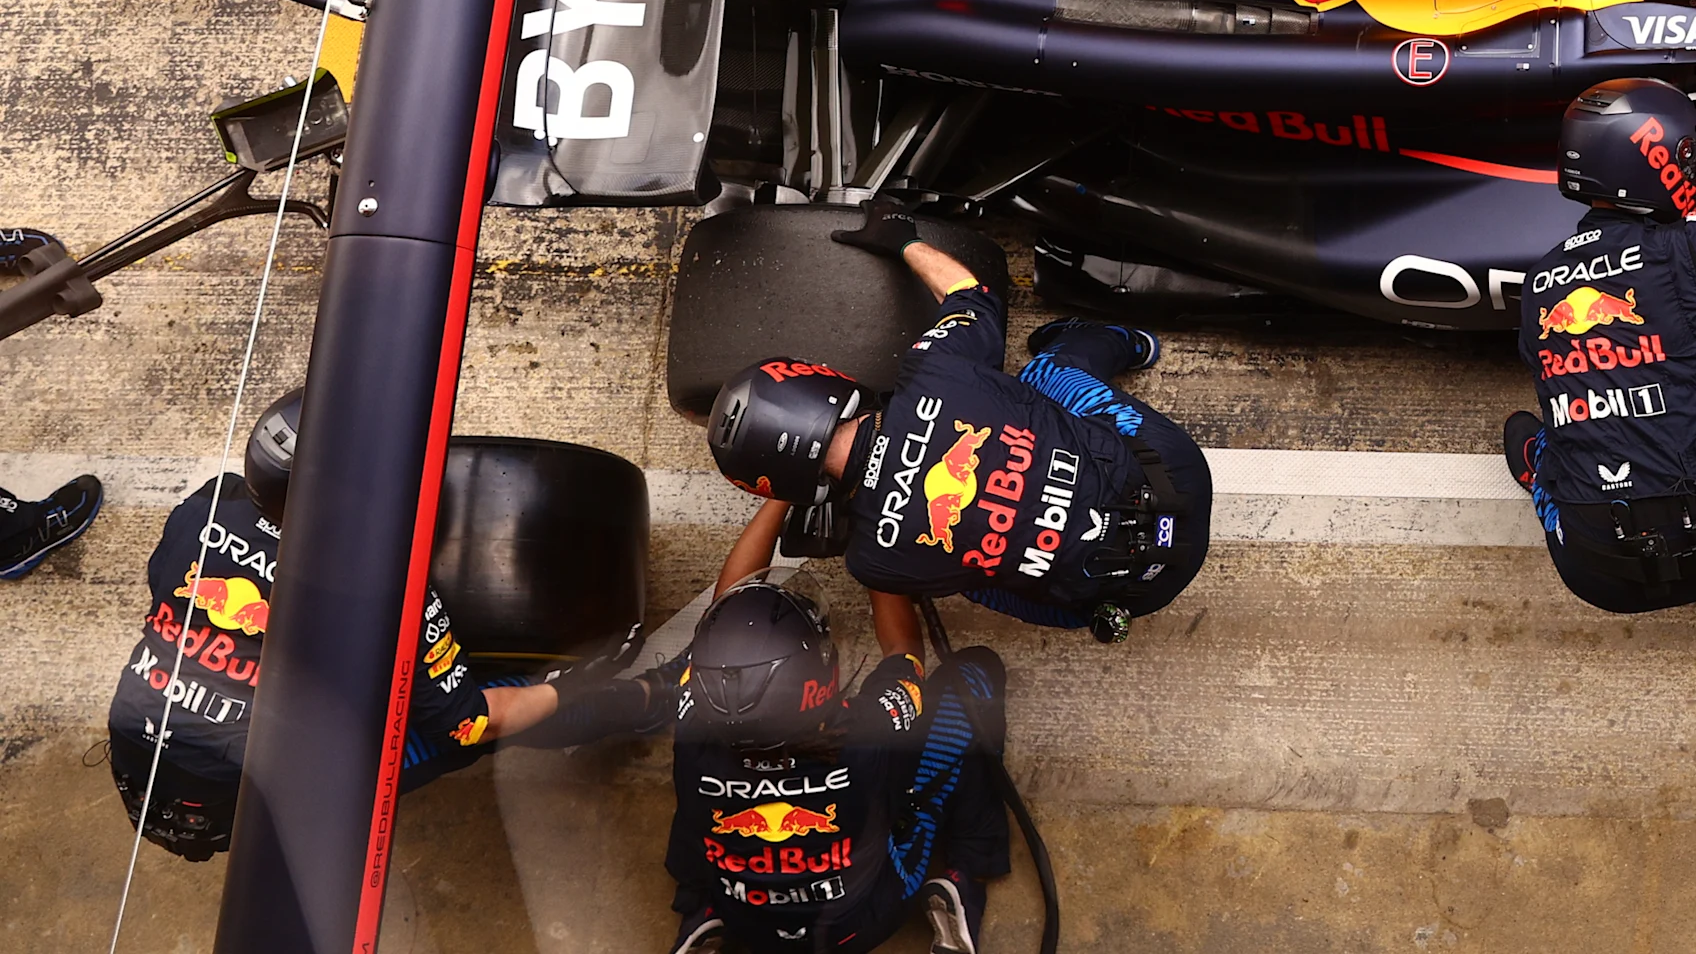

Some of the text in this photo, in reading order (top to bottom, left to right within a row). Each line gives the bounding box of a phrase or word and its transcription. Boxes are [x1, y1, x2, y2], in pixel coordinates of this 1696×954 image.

[1408, 42, 1434, 80] E
[1265, 110, 1391, 153] Bull
[1564, 228, 1602, 252] sparco
[1531, 244, 1644, 294] ORACLE
[1537, 333, 1667, 382] Red Bull
[1549, 387, 1630, 429] Mobil
[862, 434, 890, 491] sparco
[877, 395, 943, 548] ORACLE
[961, 423, 1037, 578] Red Bull
[1017, 484, 1075, 578] Mobil
[130, 645, 207, 715] Mobil
[878, 695, 902, 732] Mobil
[369, 659, 412, 889] @REDBULLRACING
[697, 766, 851, 800] ORACLE
[702, 836, 853, 875] Red Bull
[719, 875, 810, 907] Mobil
